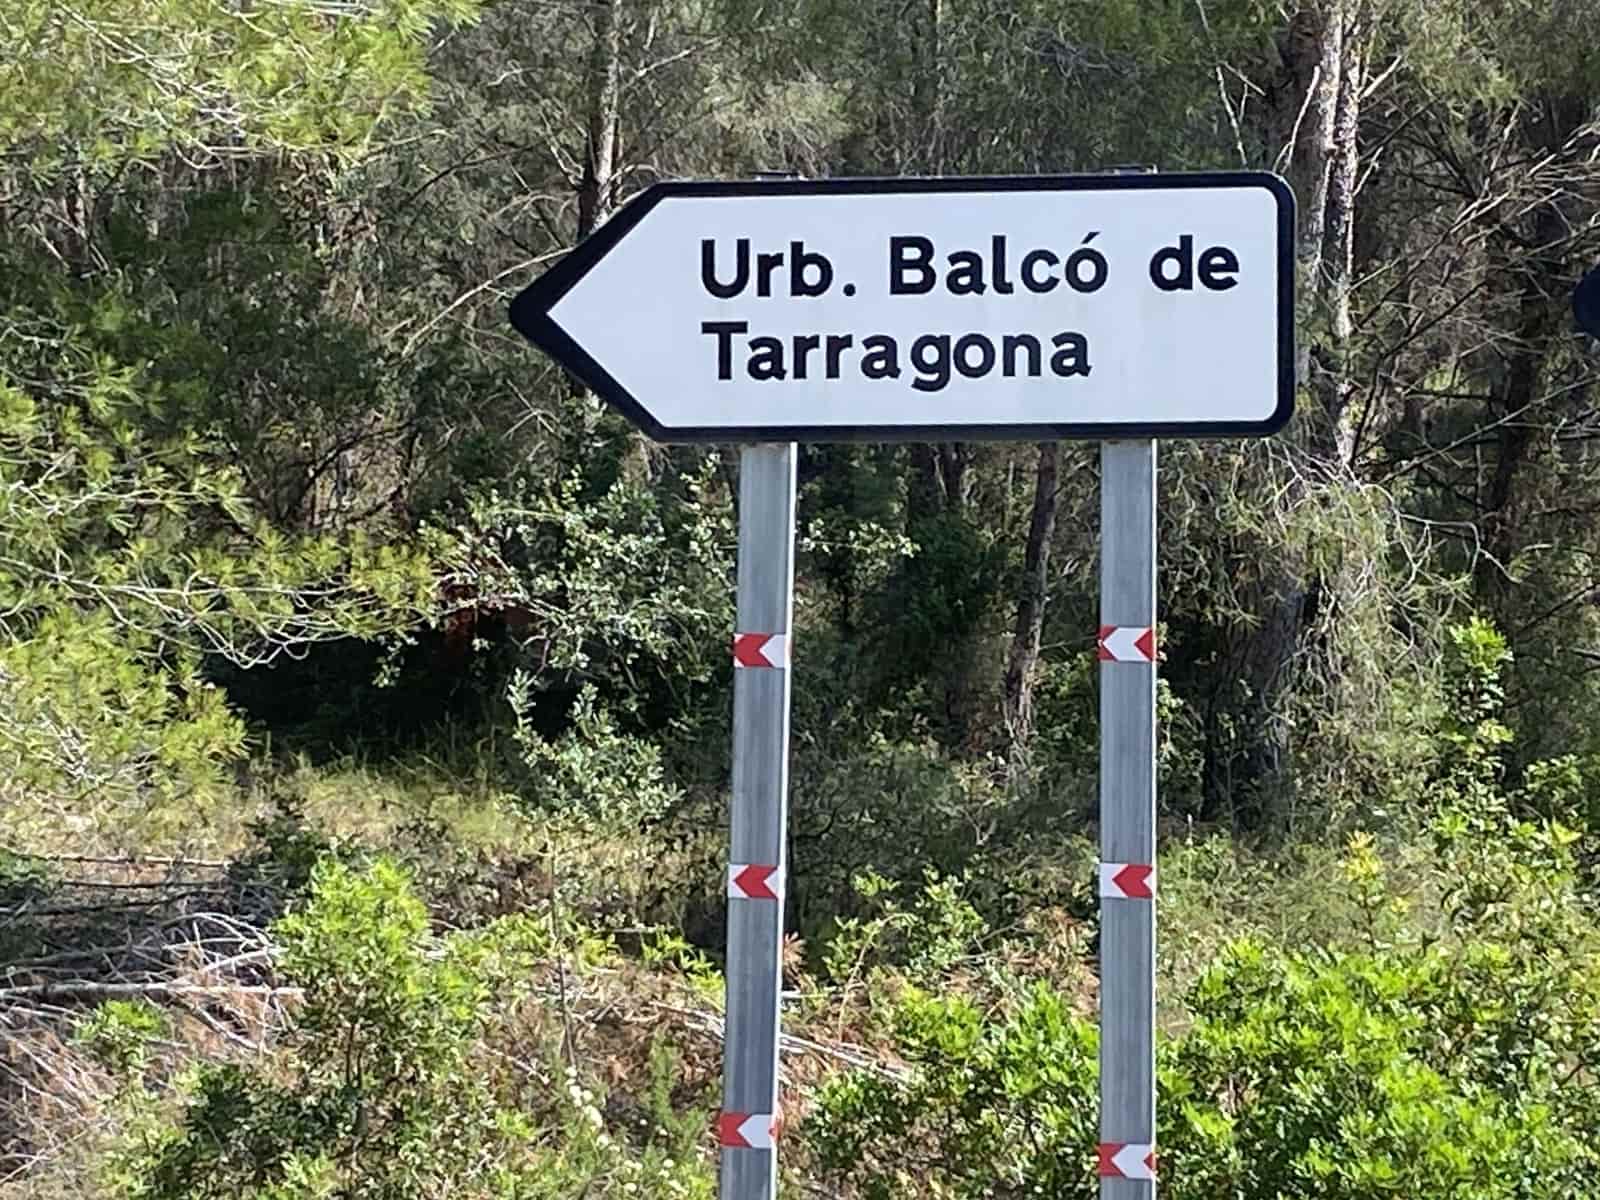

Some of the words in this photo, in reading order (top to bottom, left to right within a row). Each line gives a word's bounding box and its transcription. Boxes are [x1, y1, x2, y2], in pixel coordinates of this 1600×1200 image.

[701, 238, 856, 299] Urb.
[889, 232, 1109, 296] Balcó
[1149, 234, 1240, 291] de
[701, 321, 1092, 392] Tarragona
